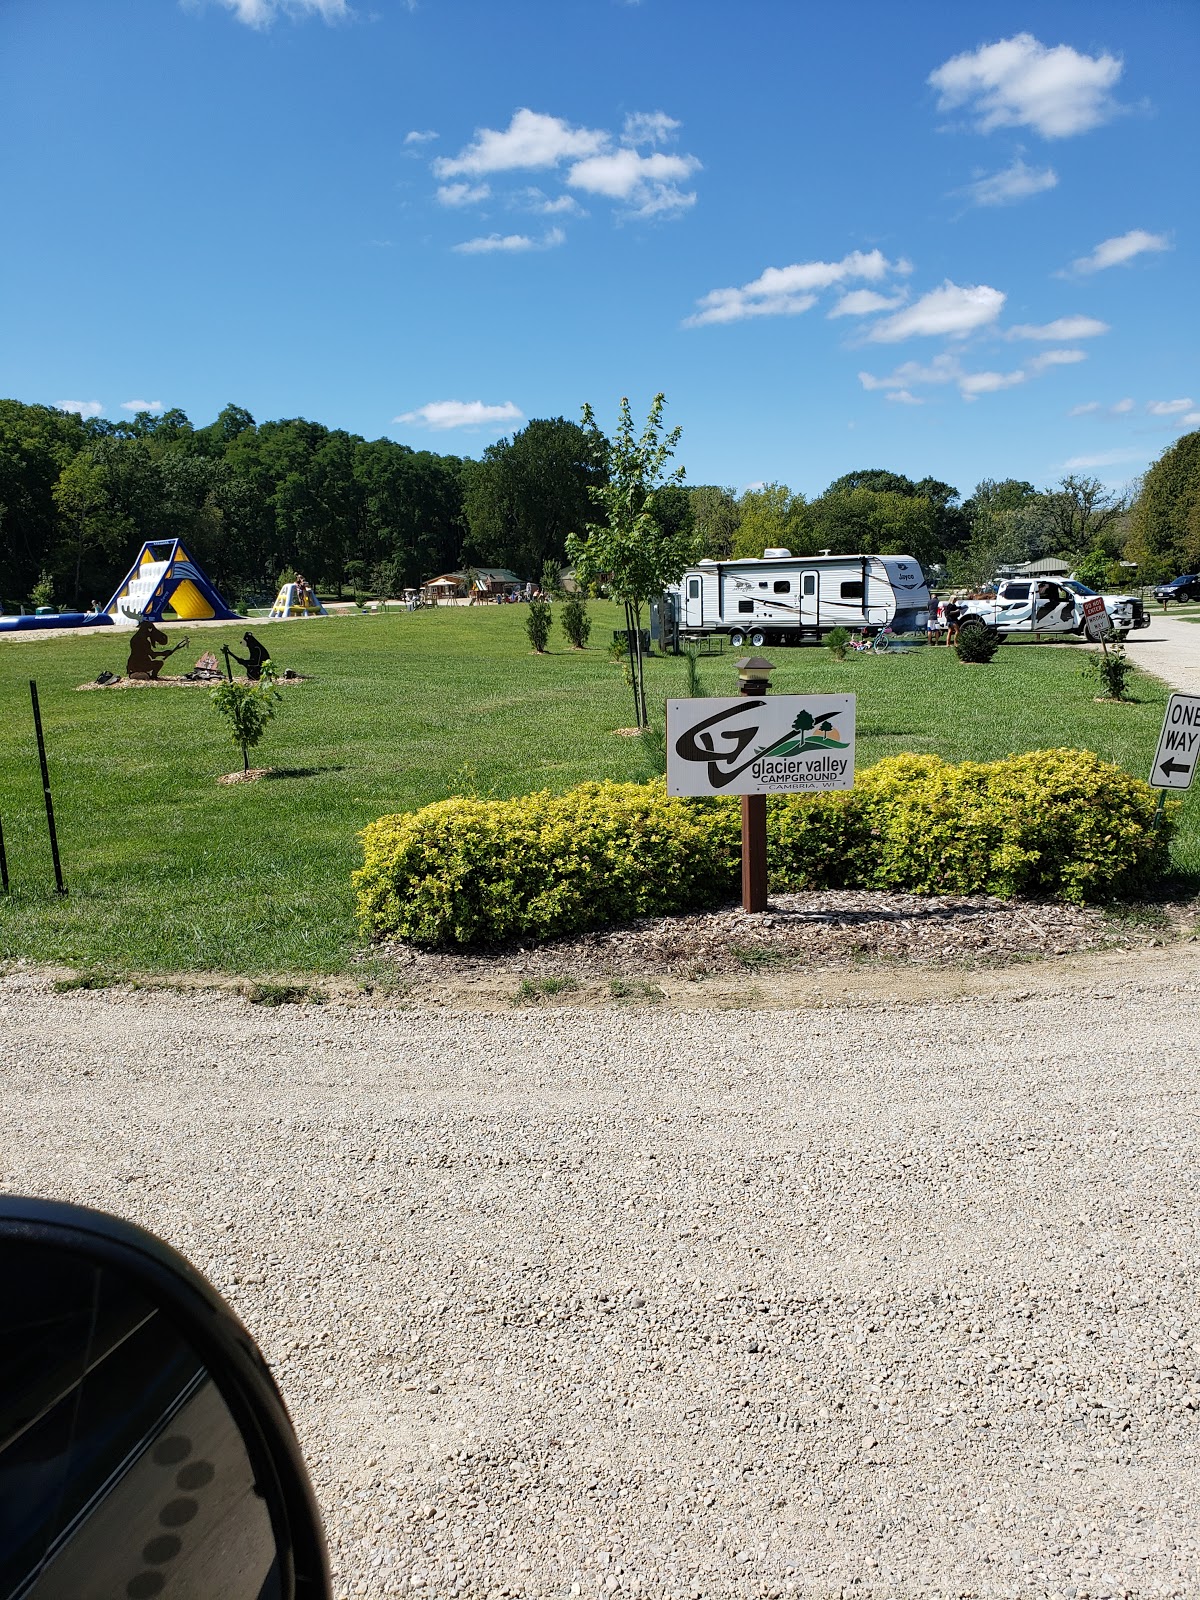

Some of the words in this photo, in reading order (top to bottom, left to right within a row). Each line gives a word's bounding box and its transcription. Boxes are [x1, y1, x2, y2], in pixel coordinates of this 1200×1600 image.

[899, 573, 914, 581] Jayco
[1092, 599, 1102, 607] NOT
[1087, 605, 1103, 614] ENTER
[1089, 613, 1106, 622] WRONG
[1171, 704, 1200, 727] ONE
[1165, 730, 1199, 752] WAY
[752, 758, 803, 779] glacier
[805, 756, 848, 775] valley
[761, 772, 838, 783] CAMPGROUND
